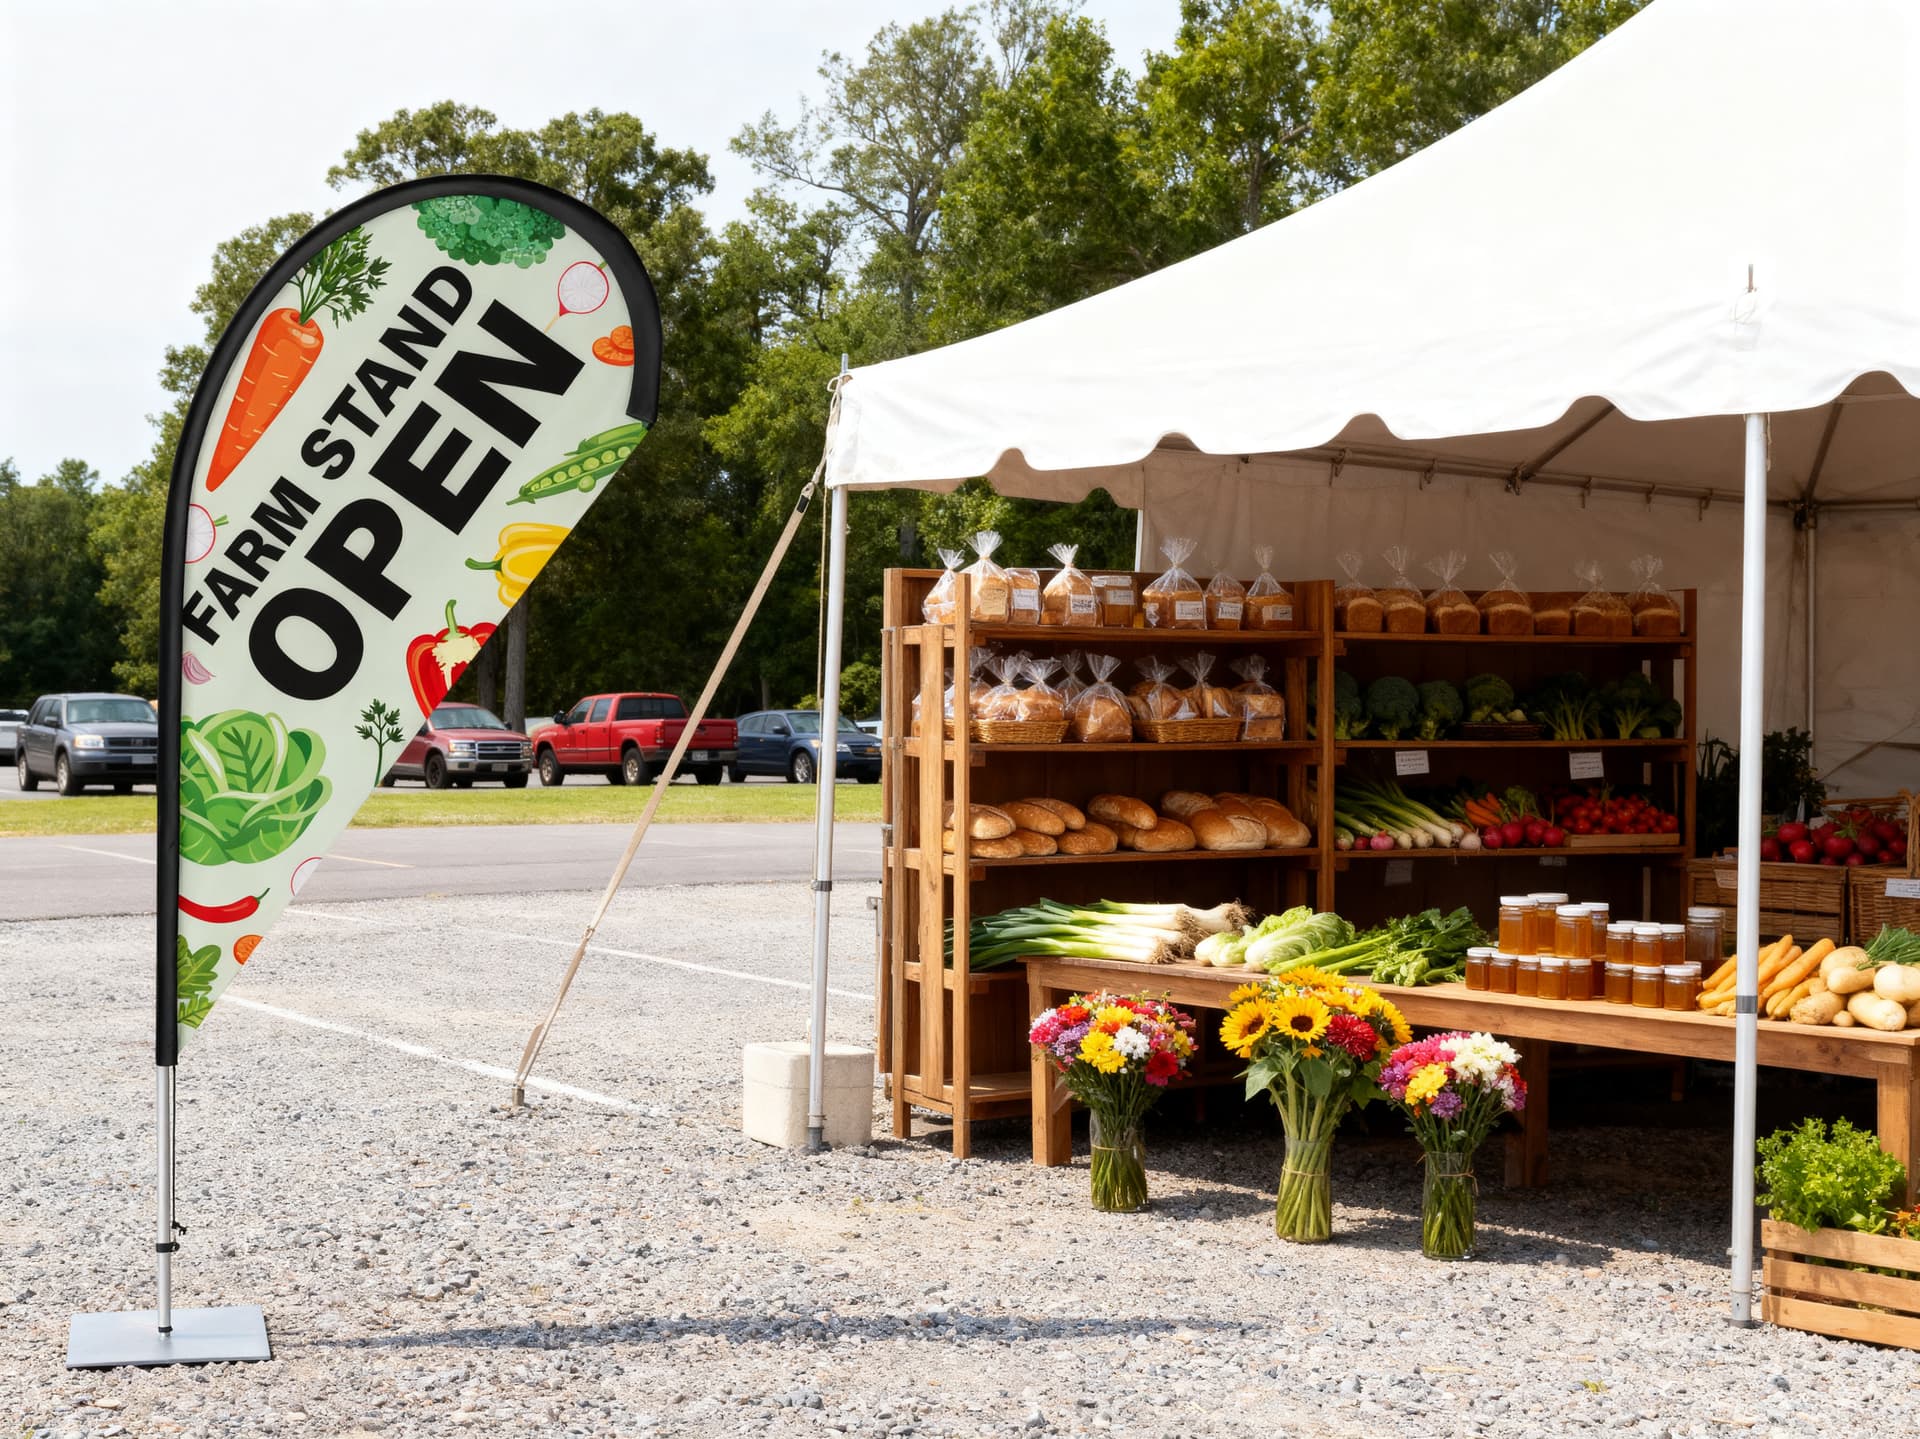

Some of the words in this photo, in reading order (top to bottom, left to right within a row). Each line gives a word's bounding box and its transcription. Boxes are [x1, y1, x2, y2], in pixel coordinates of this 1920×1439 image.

[182, 476, 321, 646] FARM
[301, 266, 473, 480] STAND
[249, 299, 585, 701] OPEN
